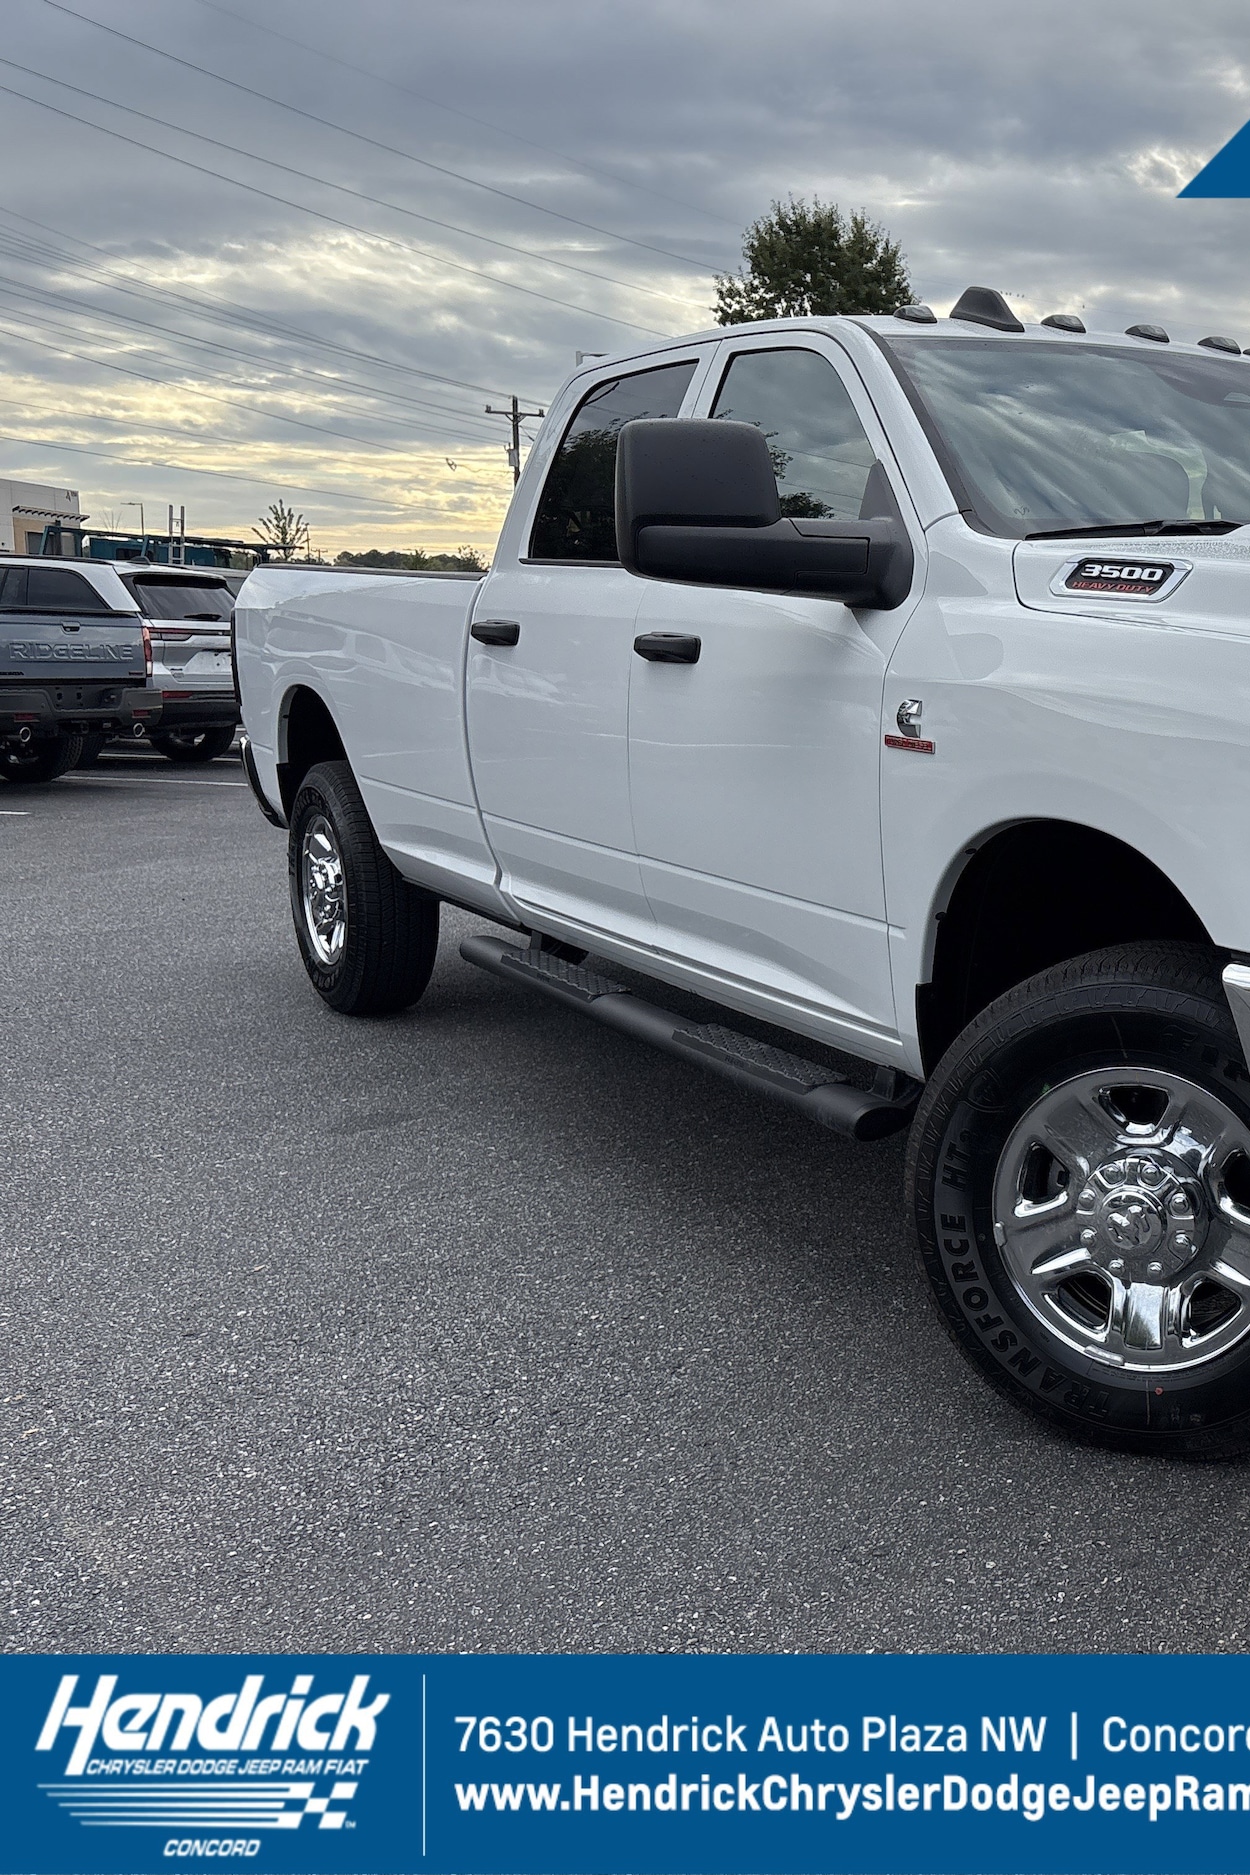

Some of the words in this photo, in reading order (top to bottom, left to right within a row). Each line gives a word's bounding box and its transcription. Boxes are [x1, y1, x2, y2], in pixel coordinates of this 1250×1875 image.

[1081, 564, 1164, 582] 3500
[1072, 581, 1115, 591] HEAVY
[1116, 584, 1156, 593] DUTY
[9, 642, 134, 661] RIDGELINE
[940, 1213, 1112, 1419] TRANSFORCE
